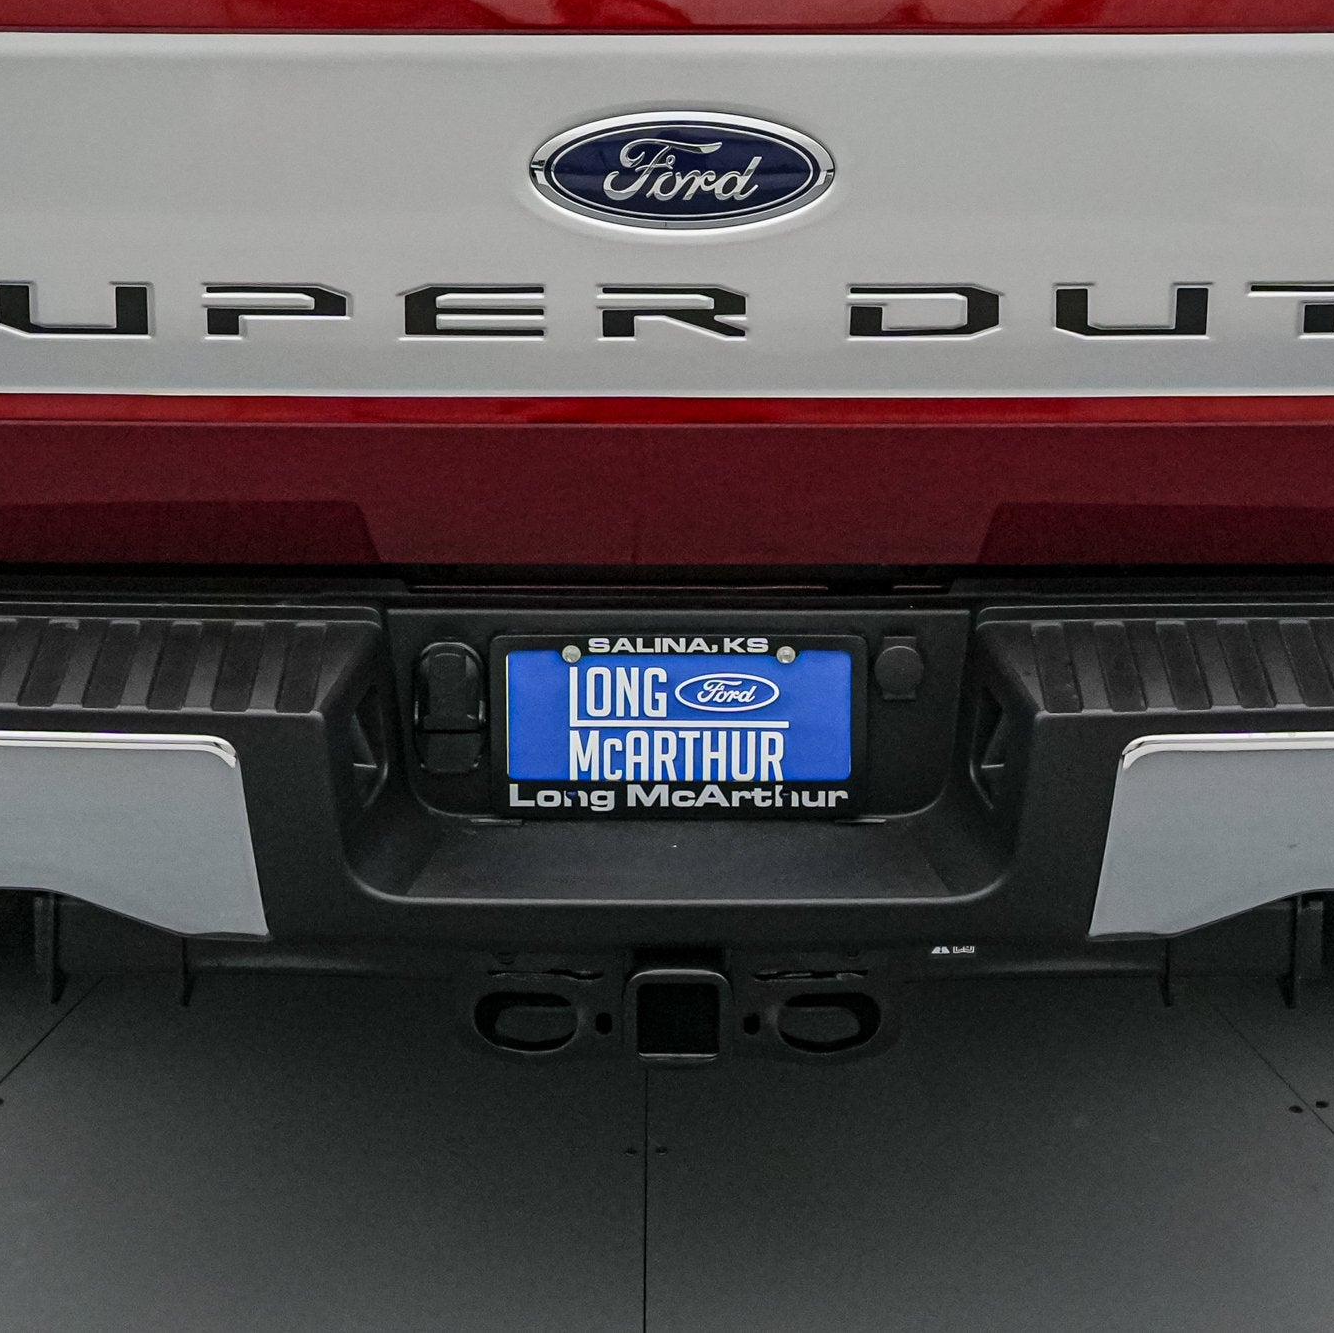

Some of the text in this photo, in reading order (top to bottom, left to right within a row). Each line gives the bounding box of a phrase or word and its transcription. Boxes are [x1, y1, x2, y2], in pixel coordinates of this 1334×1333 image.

[603, 138, 762, 201] Ford
[588, 637, 769, 654] SALINA, KS
[569, 666, 758, 727] LONG Ford
[569, 729, 785, 781] McARTHUR
[509, 783, 849, 812] Long McArthur
